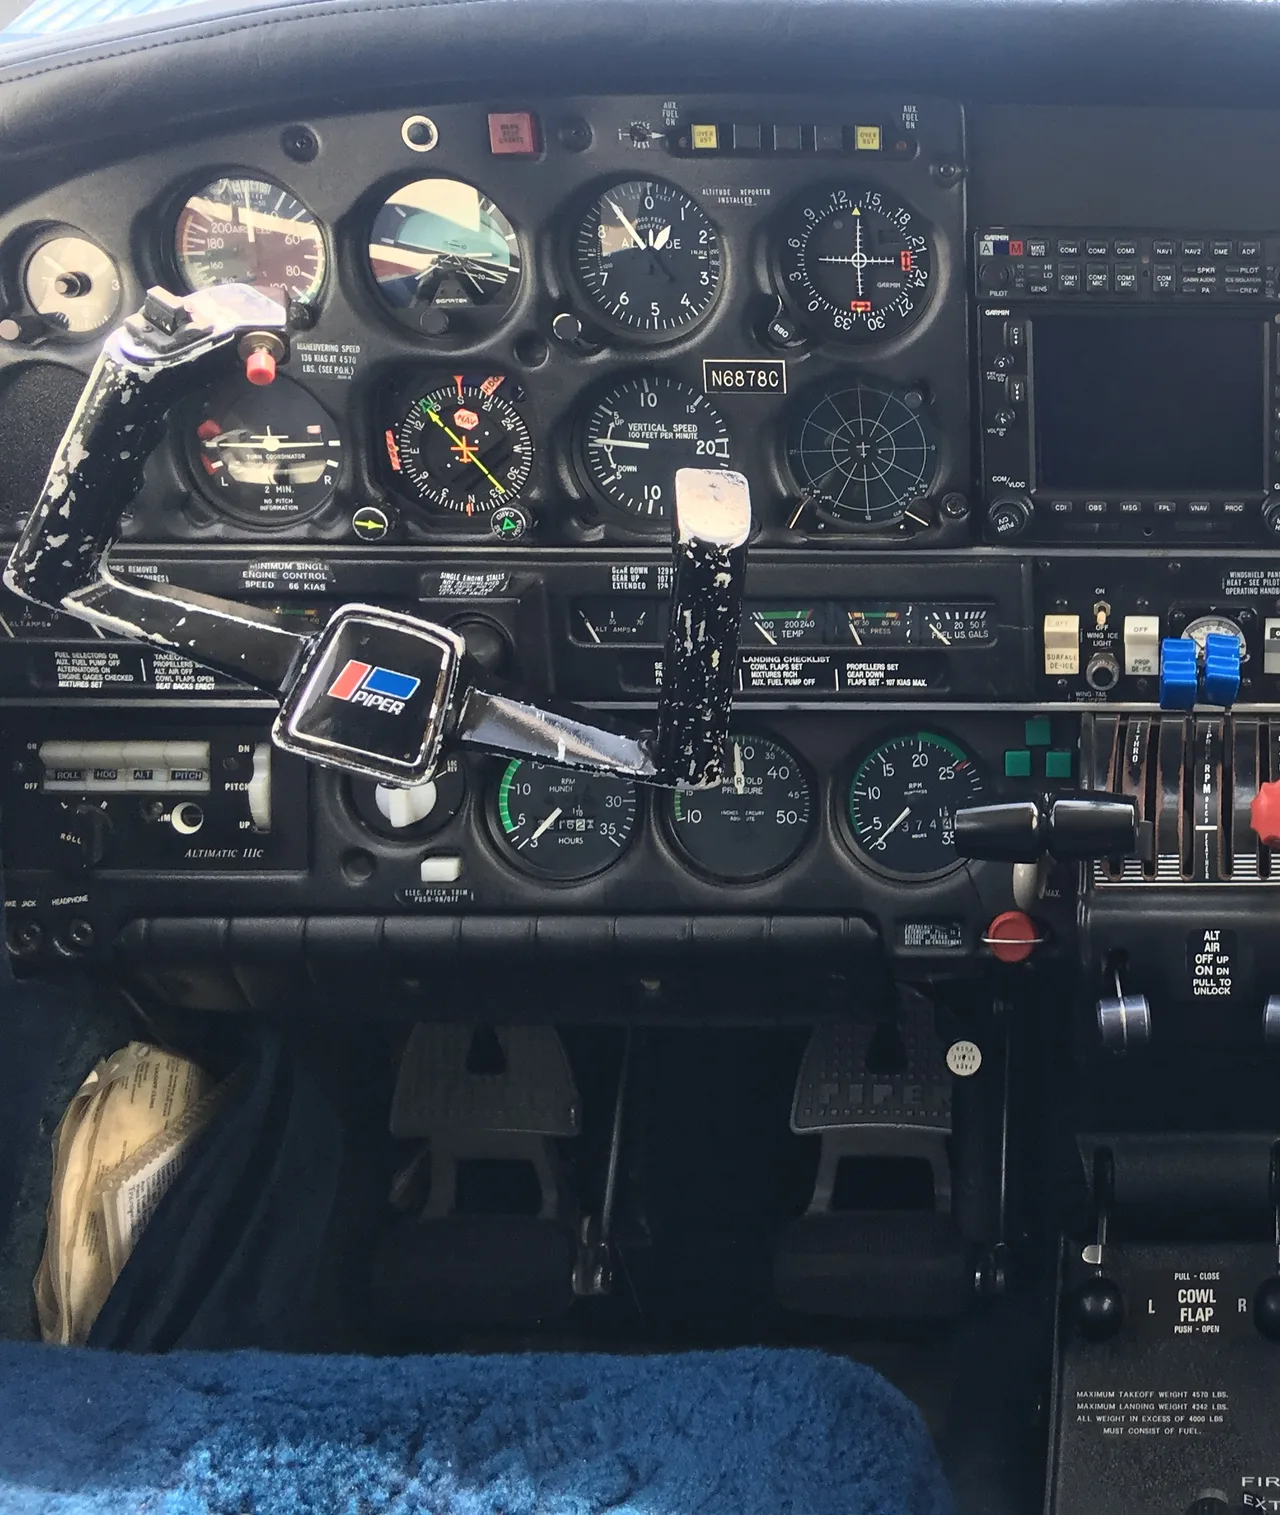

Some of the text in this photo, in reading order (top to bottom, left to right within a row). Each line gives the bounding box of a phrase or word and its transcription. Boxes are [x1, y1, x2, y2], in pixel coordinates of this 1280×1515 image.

[662, 110, 679, 118] FUEL
[666, 118, 676, 126] ON
[702, 188, 771, 196] ALTITUDE REPORTER
[830, 190, 849, 205] 12
[865, 191, 882, 206] 15
[894, 208, 912, 226] 18
[699, 230, 708, 244] 2
[206, 238, 224, 249] 180
[700, 271, 710, 286] 3
[680, 292, 690, 307] 4
[773, 323, 790, 338] OBS
[296, 342, 361, 353] MANEUVERING SPEED
[712, 370, 779, 387] N6878C
[640, 392, 658, 408] 10
[628, 423, 698, 432] VERTICAL SPEED
[696, 440, 716, 455] 20
[242, 571, 328, 580] ENGINE CONTROL
[1230, 571, 1264, 579] WINDSHIELD
[288, 582, 300, 590] 66
[304, 583, 326, 591] KIAS
[1226, 578, 1242, 586] HEAT
[1226, 587, 1258, 595] OPERATING
[352, 690, 406, 716] PIPER
[912, 754, 928, 767] 20
[134, 770, 151, 779] ALT
[174, 771, 202, 780] PITCH
[767, 766, 790, 780] 40
[938, 766, 955, 780] 25
[776, 810, 798, 824] 50
[185, 848, 238, 858] ALTIMATIC
[1204, 930, 1220, 941] ALT
[1204, 942, 1220, 952] AIR
[1195, 954, 1230, 964] OFF UP
[1195, 966, 1230, 976] ON DN
[1192, 978, 1232, 987] PULL TO
[1194, 987, 1231, 996] UNLOCK
[1174, 1272, 1220, 1280] PULL CLOSE
[1178, 1288, 1216, 1304] COWL
[1148, 1299, 1155, 1314] L
[1238, 1298, 1247, 1312] R
[1180, 1308, 1214, 1322] FLAP
[1174, 1325, 1220, 1334] PUSH OPEN
